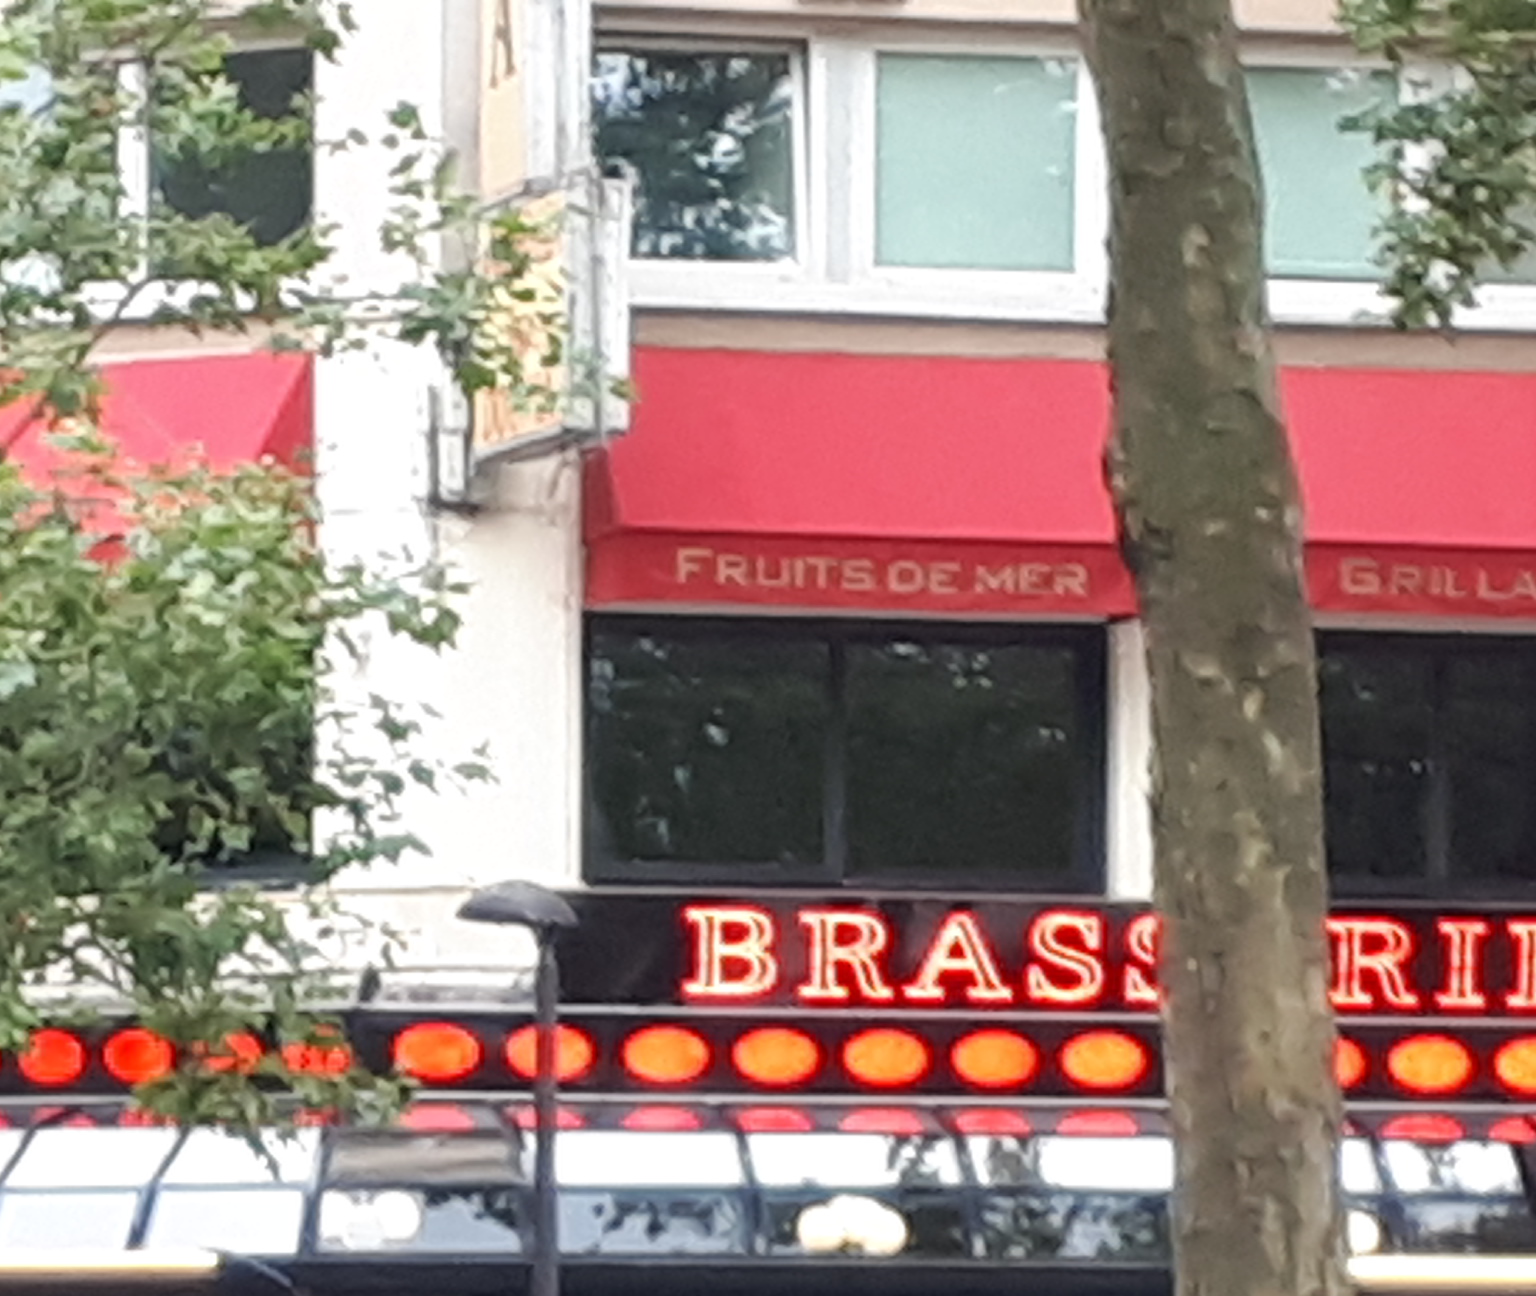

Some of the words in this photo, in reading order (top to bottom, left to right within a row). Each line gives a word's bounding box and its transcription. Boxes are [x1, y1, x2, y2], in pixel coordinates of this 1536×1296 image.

[675, 547, 875, 591] FRUITS
[888, 561, 961, 595] DE
[974, 562, 1088, 597] MER
